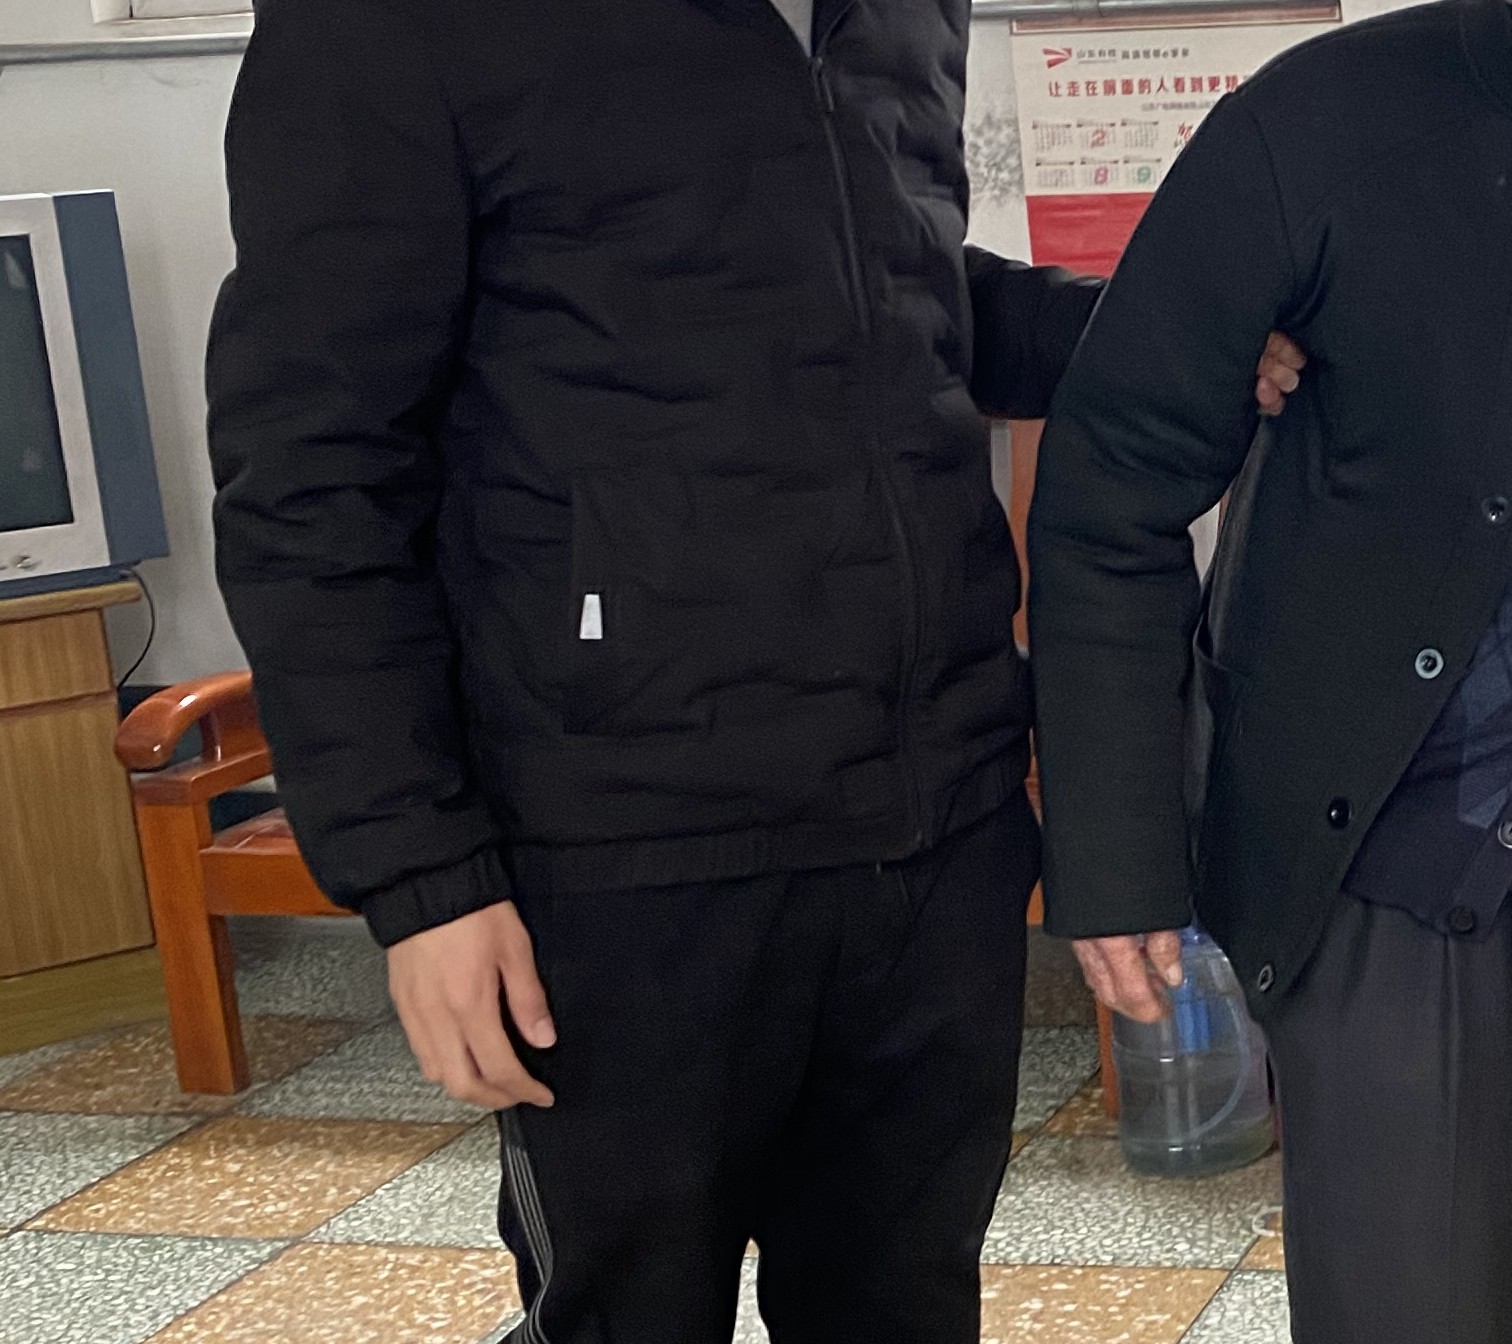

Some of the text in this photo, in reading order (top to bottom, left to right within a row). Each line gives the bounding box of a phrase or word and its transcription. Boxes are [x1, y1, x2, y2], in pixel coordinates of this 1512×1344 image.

[1049, 75, 1248, 97] 让走在前面的人看到更精
